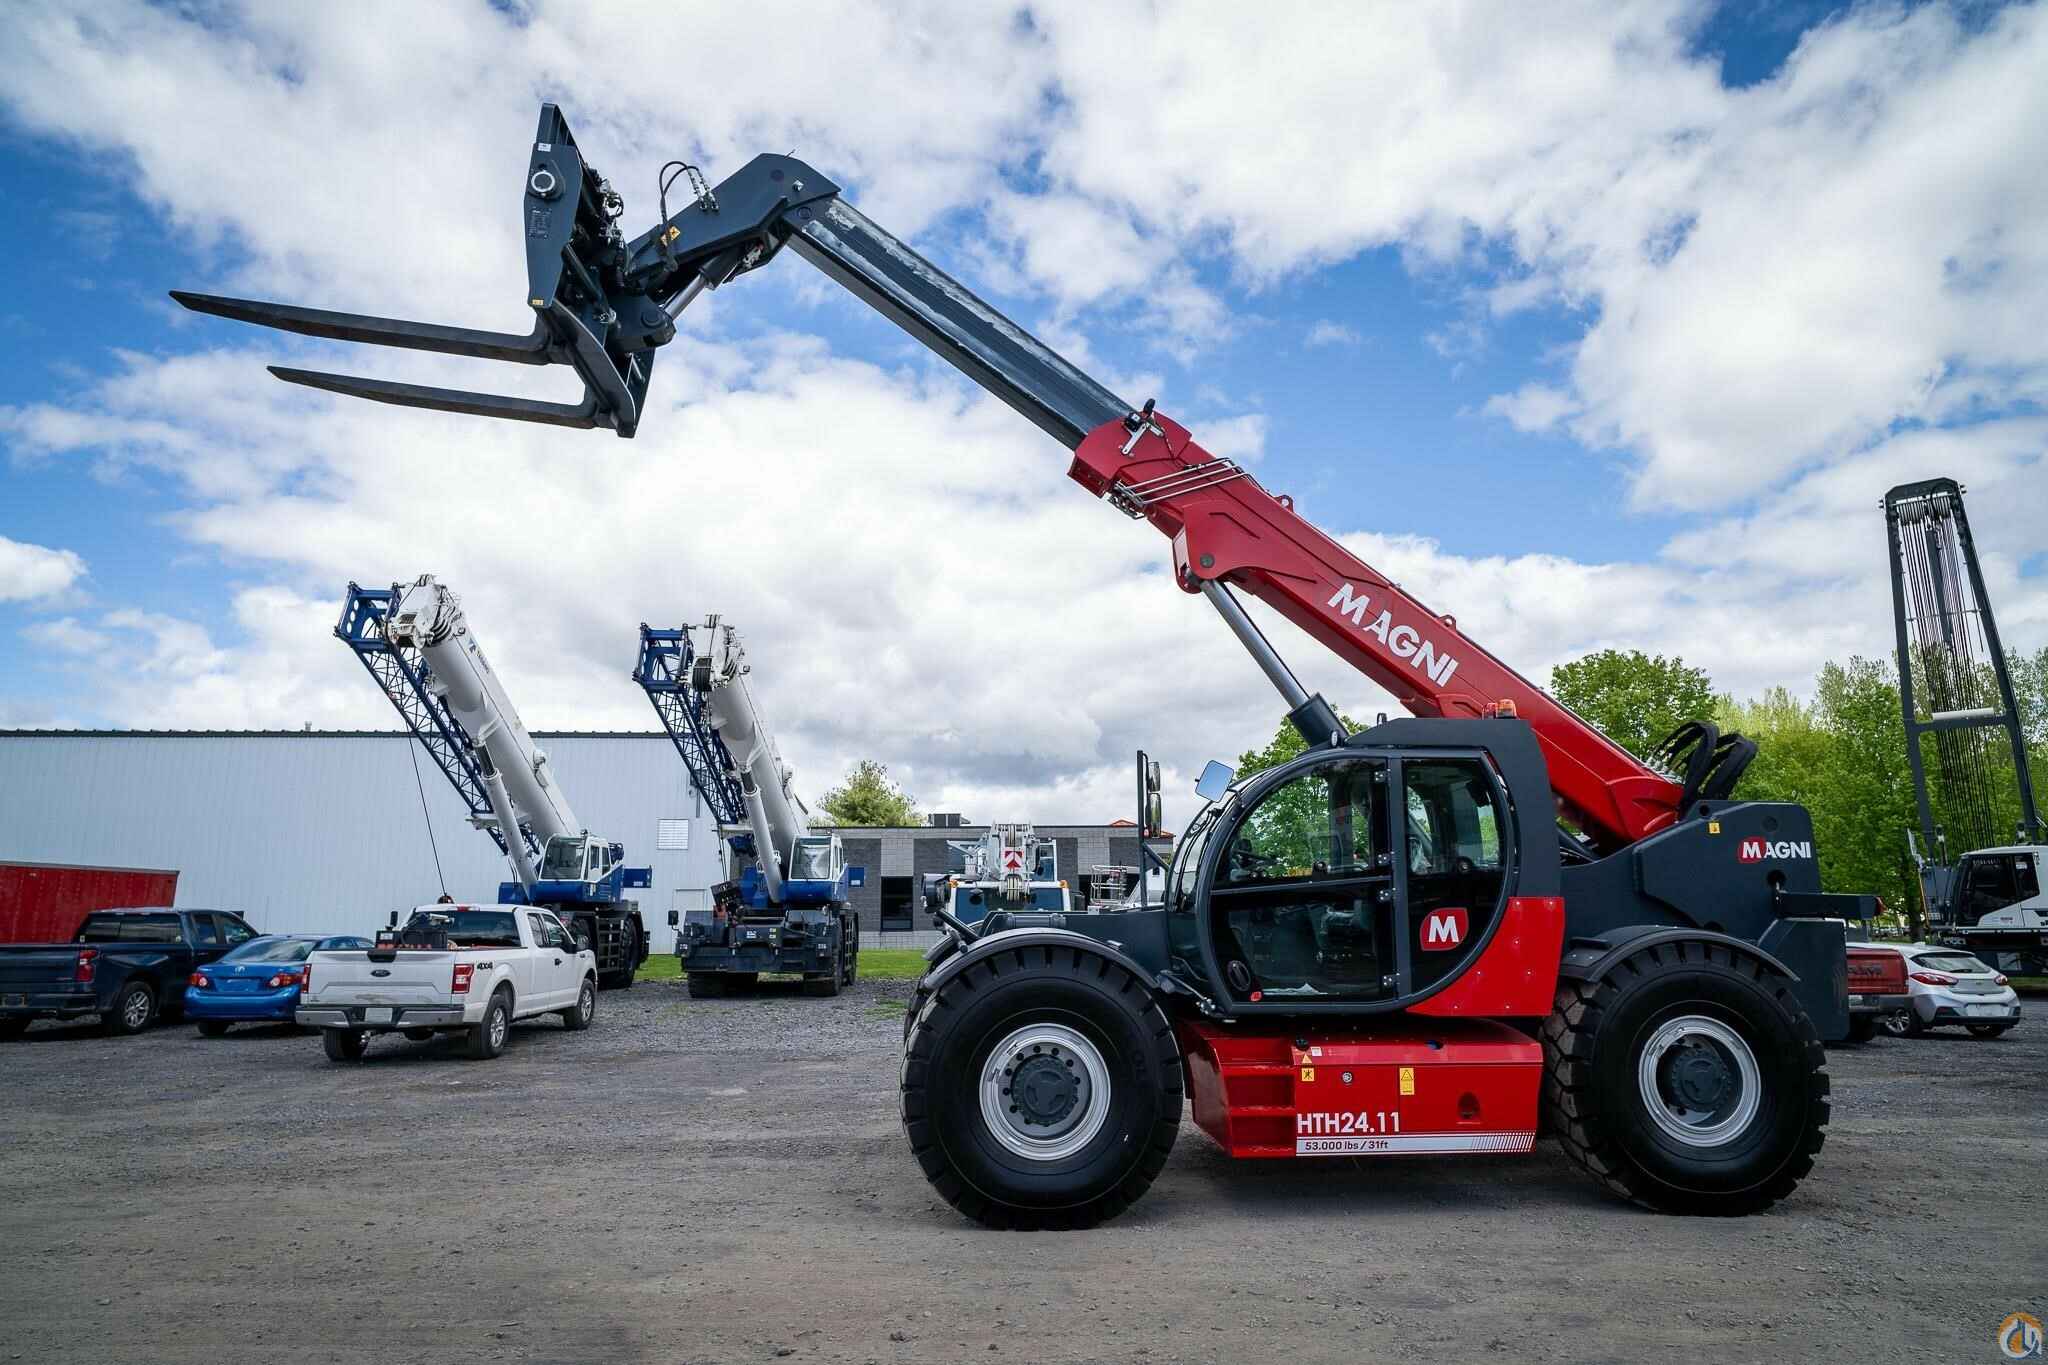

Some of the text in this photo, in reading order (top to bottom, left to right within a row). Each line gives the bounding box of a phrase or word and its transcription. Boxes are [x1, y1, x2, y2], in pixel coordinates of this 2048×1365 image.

[1327, 582, 1459, 688] MAGNI
[1742, 841, 1811, 859] MAGNI
[1428, 915, 1459, 943] M
[1297, 1111, 1399, 1134] HTH24.11
[1305, 1141, 1342, 1150] 53.000
[1344, 1140, 1359, 1150] lbs
[1368, 1140, 1389, 1149] 31ft
